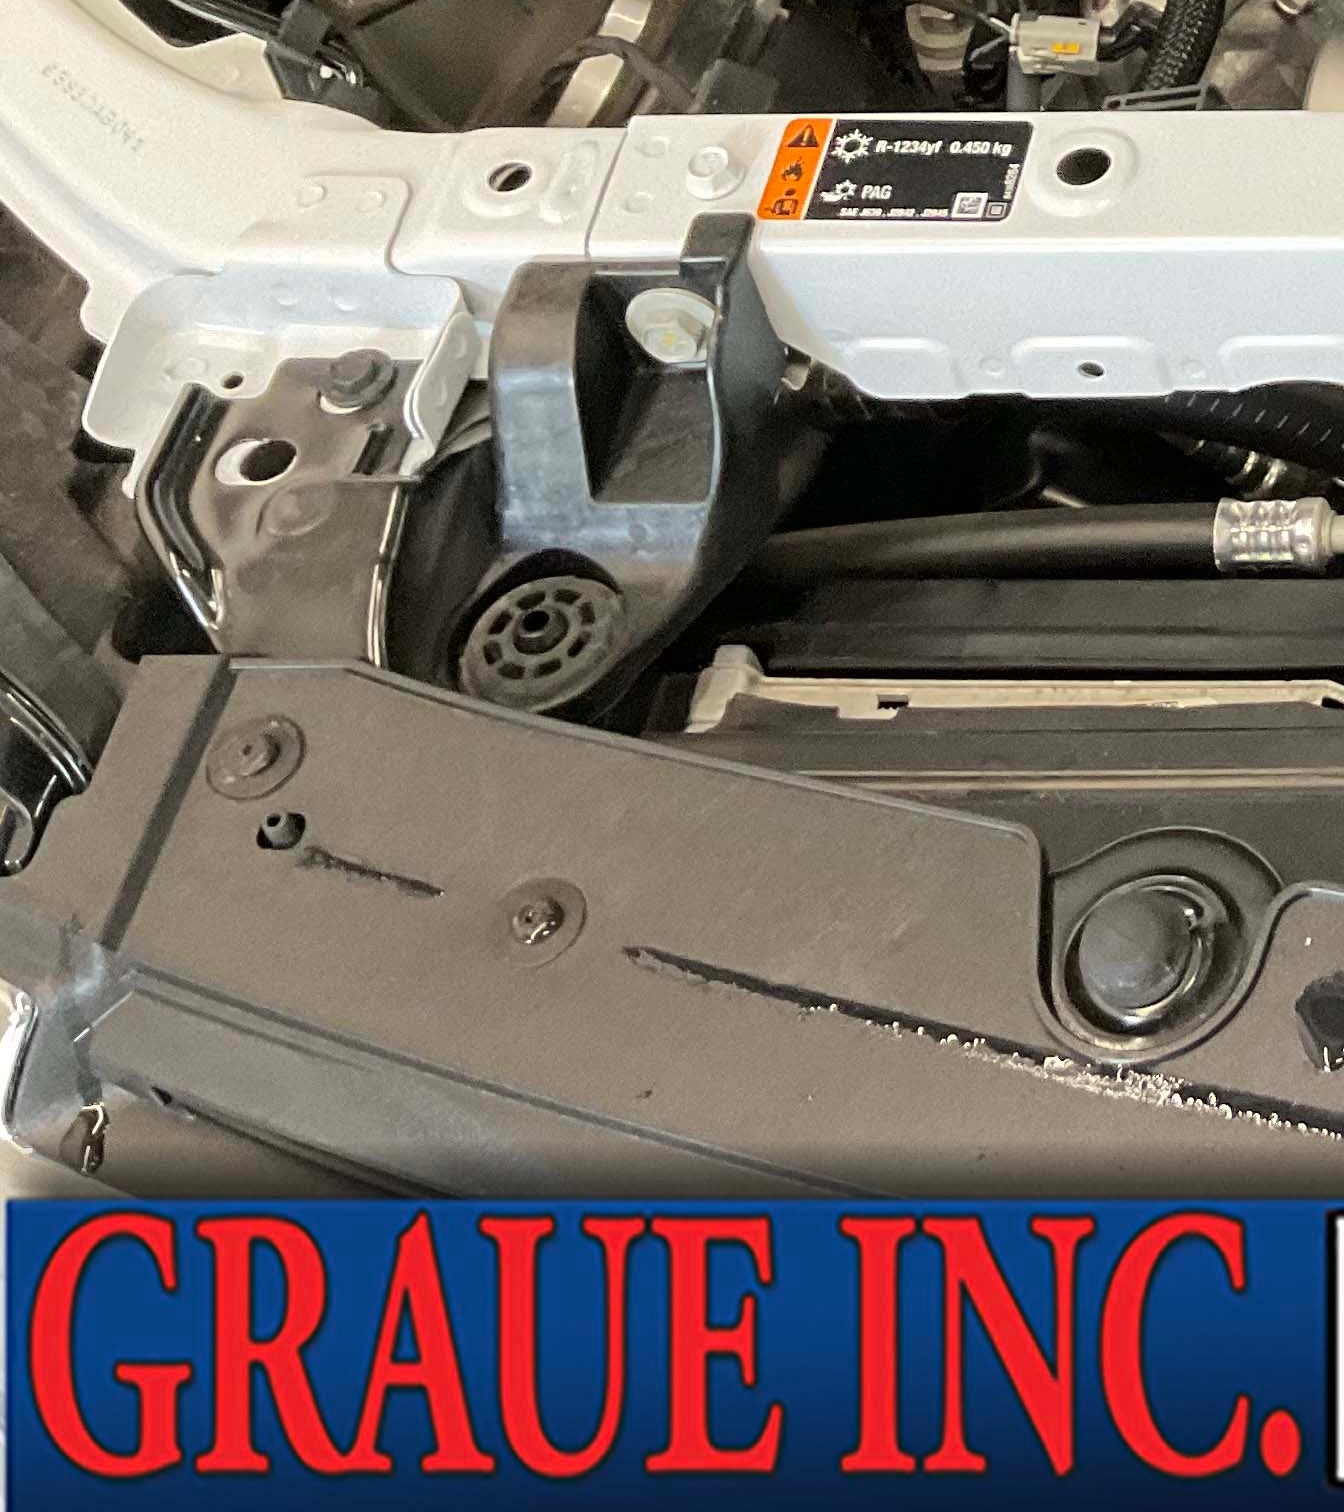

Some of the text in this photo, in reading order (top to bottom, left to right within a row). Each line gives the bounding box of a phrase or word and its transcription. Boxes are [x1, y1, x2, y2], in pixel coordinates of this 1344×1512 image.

[875, 139, 1012, 157] R-1234yf 0.450 kg
[861, 184, 893, 200] PAG
